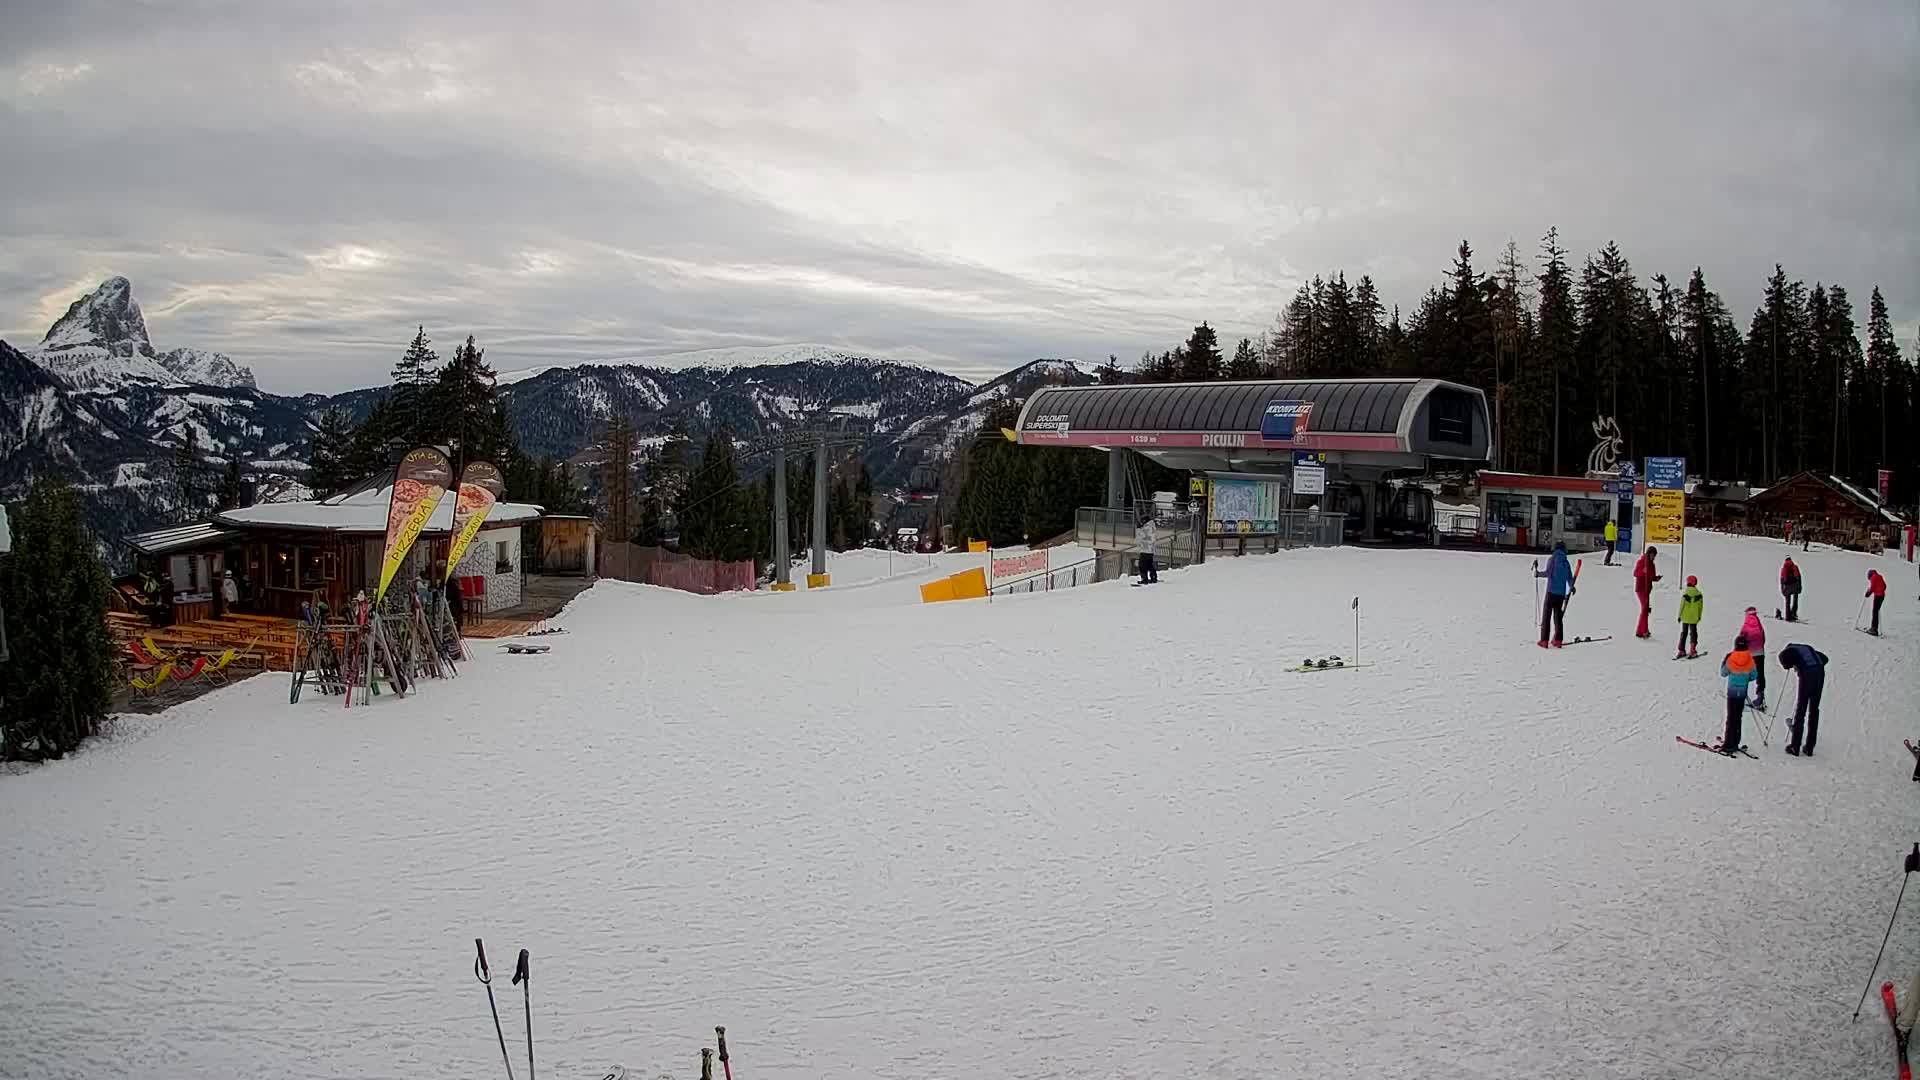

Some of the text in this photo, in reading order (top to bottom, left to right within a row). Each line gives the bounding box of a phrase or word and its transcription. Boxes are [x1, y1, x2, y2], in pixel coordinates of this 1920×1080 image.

[1202, 434, 1245, 447] PICULIN
[391, 504, 431, 561] PIZZERIA
[449, 514, 483, 566] RESTAURANT
